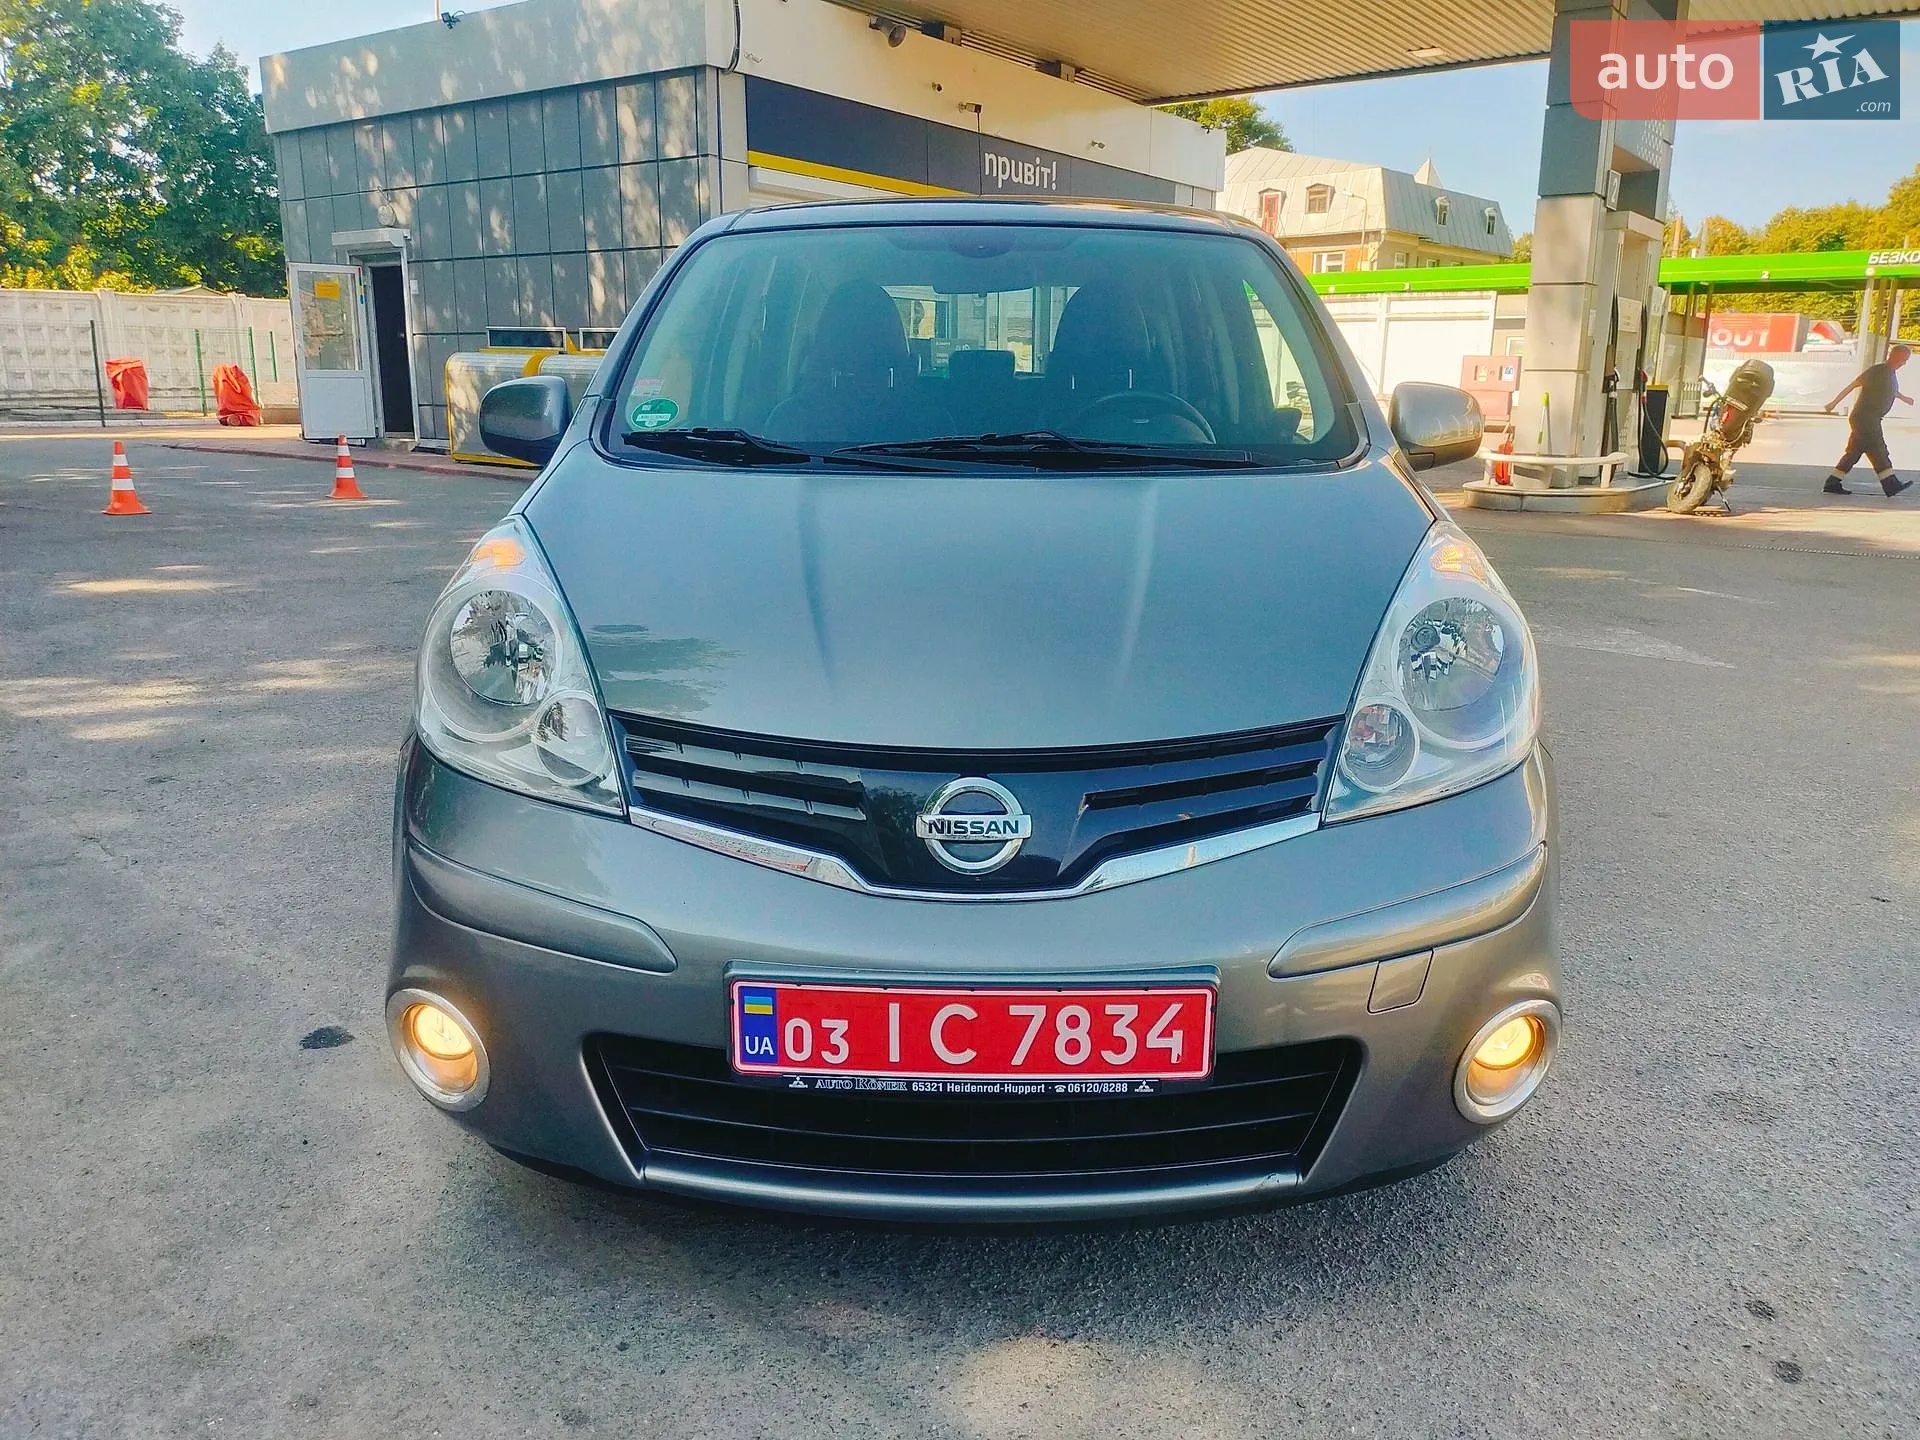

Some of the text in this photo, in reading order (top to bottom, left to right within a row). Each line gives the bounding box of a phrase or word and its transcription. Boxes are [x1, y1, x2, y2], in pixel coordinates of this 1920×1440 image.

[928, 820, 1019, 835] NISSAN
[784, 1017, 849, 1065] 03
[1008, 1003, 1184, 1066] 7834
[744, 1035, 775, 1056] UA
[814, 1078, 853, 1090] AUTO
[911, 1082, 943, 1092] 65321
[946, 1082, 1046, 1095] Heidenrod-Huppert
[1067, 1082, 1128, 1094] 06120/8288
